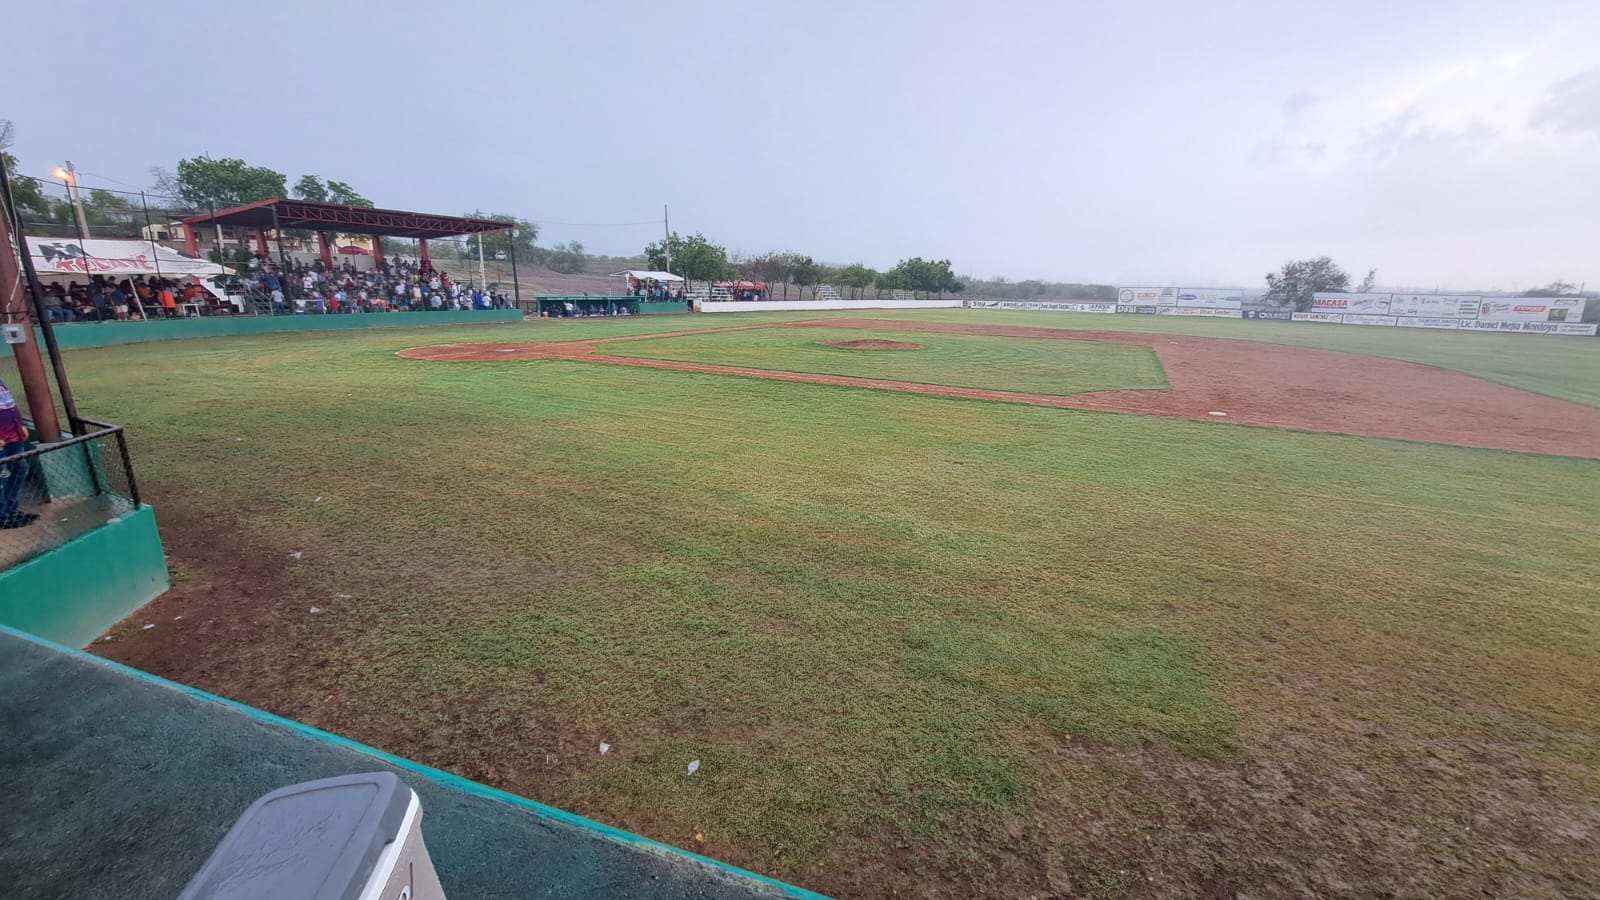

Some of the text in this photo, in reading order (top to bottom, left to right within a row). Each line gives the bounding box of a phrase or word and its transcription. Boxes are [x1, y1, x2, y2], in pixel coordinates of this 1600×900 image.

[1314, 299, 1348, 307] MACASA
[1474, 321, 1498, 329] Daniel
[1523, 322, 1558, 334] Montoya
